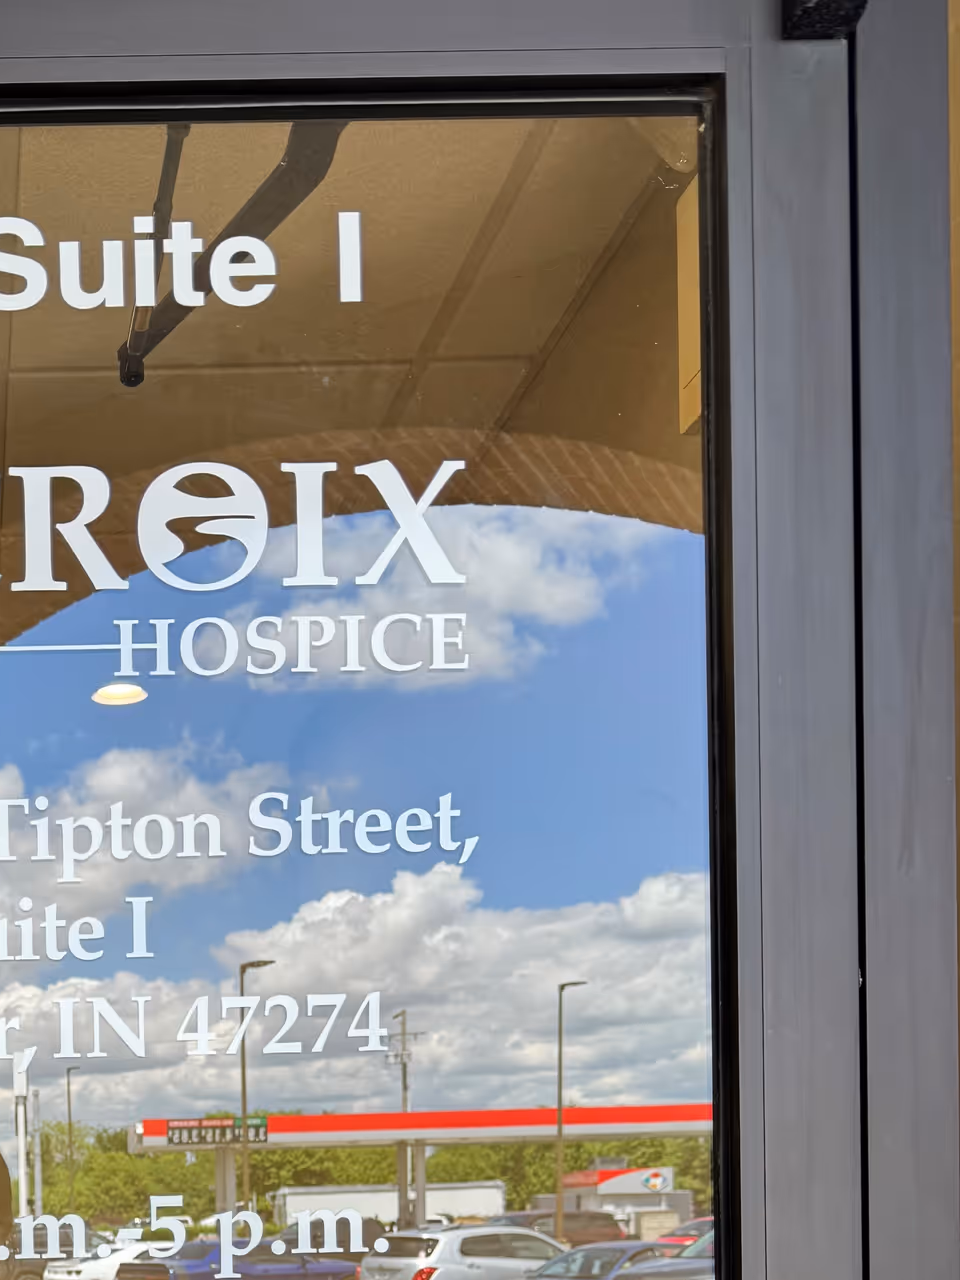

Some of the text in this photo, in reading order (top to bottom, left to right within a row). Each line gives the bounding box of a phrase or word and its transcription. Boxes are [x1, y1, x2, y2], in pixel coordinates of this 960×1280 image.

[113, 612, 470, 677] HOSPICE
[247, 791, 479, 865] Street,
[126, 895, 154, 959] I
[52, 995, 151, 1059] IN
[177, 991, 388, 1055] 47274
[215, 1204, 389, 1279] p.m.
